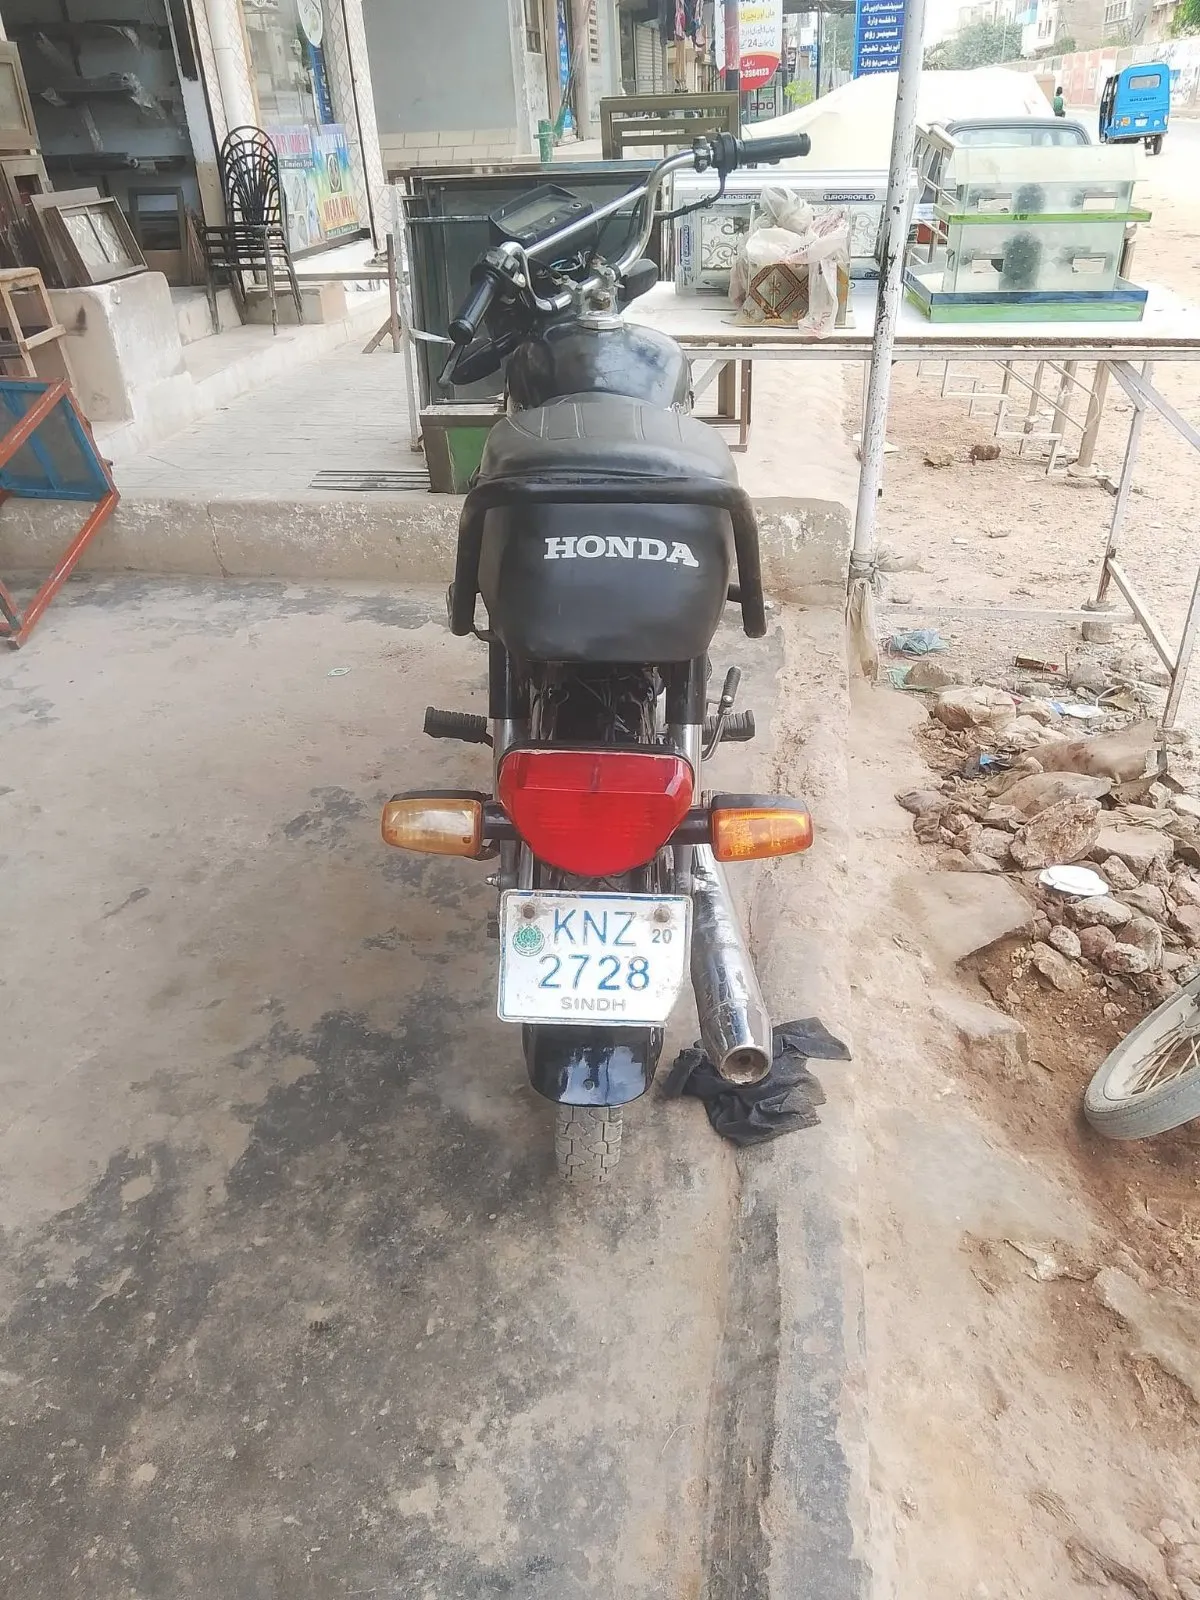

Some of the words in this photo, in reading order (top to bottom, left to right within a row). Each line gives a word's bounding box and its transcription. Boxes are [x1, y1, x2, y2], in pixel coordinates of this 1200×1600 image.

[748, 38, 757, 48] 24
[544, 535, 699, 567] HONDA
[553, 908, 637, 947] KNZ
[651, 929, 672, 944] 20
[538, 953, 650, 991] 2728
[561, 996, 626, 1012] SINDH
